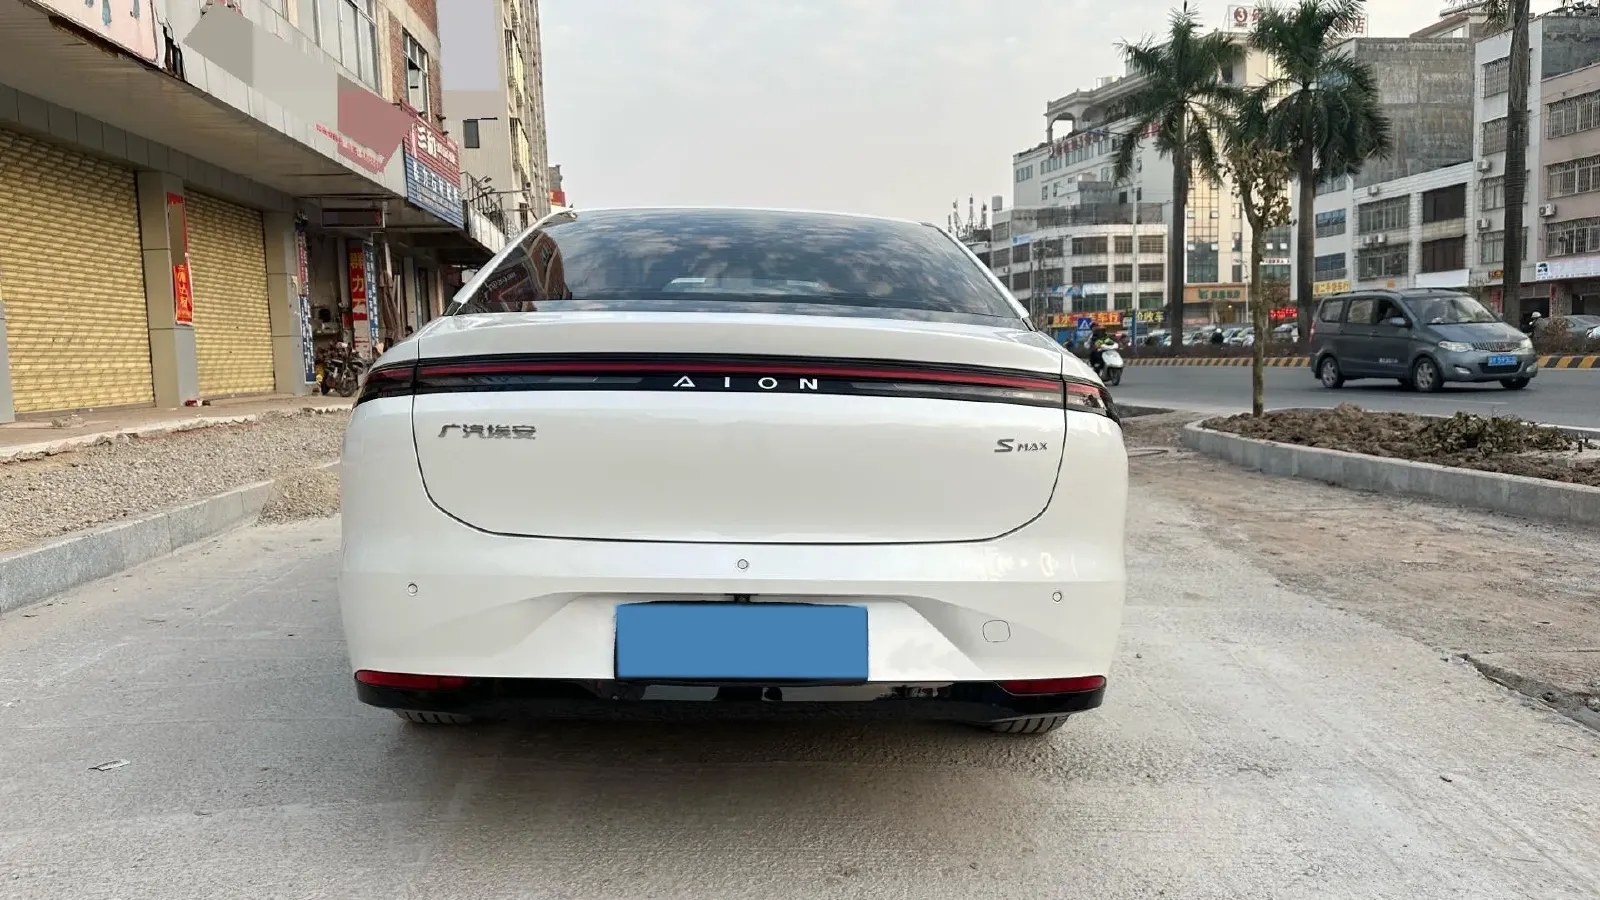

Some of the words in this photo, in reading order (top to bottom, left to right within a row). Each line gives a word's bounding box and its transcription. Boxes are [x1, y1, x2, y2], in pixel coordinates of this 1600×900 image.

[673, 376, 818, 390] AION
[438, 424, 536, 440] 广汽埃安
[994, 438, 1015, 453] S
[1017, 441, 1048, 452] MAX
